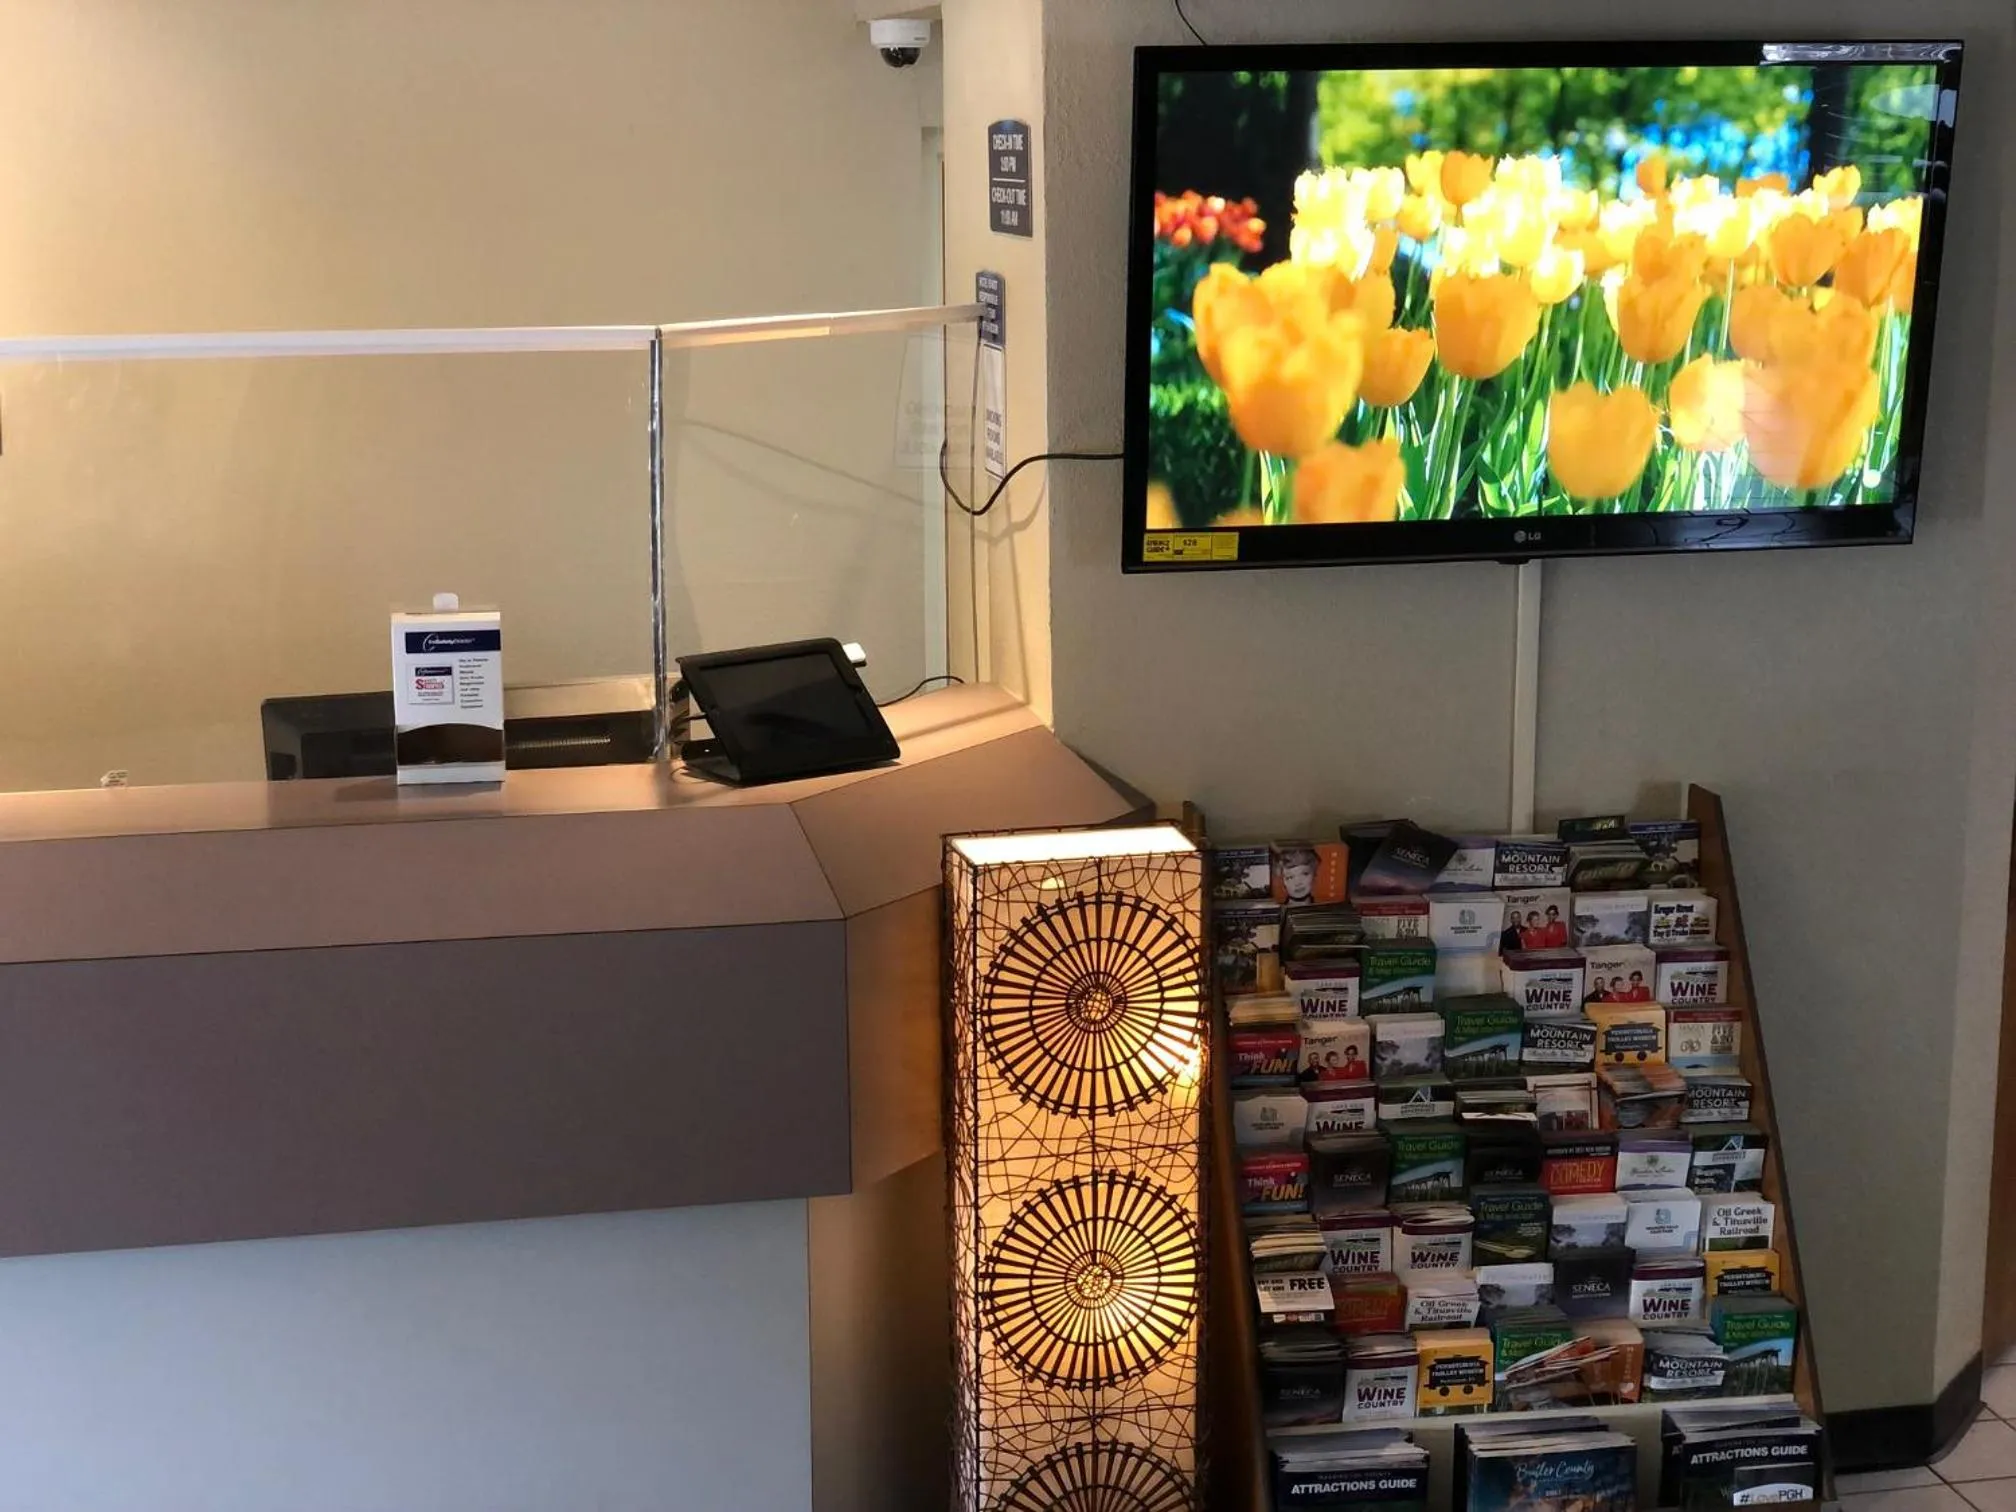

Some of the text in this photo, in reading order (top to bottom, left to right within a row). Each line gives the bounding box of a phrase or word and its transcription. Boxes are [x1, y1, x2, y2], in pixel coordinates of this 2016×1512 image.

[1528, 532, 1542, 540] LG
[1501, 854, 1561, 864] MOUNTAIN
[1508, 864, 1551, 873] RESORT
[1506, 894, 1540, 904] Tanger
[1590, 961, 1624, 970] Tanger
[1671, 982, 1718, 997] WINE
[1526, 988, 1573, 1004] WINE
[1300, 998, 1348, 1014] WINE
[1526, 1002, 1571, 1012] COUNTRY
[1530, 1028, 1592, 1042] MOUNTAIN
[1304, 1036, 1338, 1046] Tanger
[1536, 1039, 1581, 1050] RESORT
[1250, 1058, 1294, 1074] FUN!
[1692, 1098, 1738, 1109] RESORT
[1316, 1120, 1364, 1132] WINE
[1397, 1140, 1426, 1152] Travel
[1550, 1160, 1607, 1185] COMEDY
[1247, 1177, 1275, 1188] Think
[1262, 1184, 1305, 1200] FUN!
[1720, 1226, 1760, 1236] Railroad
[1331, 1250, 1380, 1266] WINE
[1411, 1252, 1460, 1264] WINE
[1332, 1264, 1380, 1274] COUNTRY
[1411, 1262, 1458, 1270] COUNTRY
[1289, 1277, 1325, 1291] FREE
[1642, 1298, 1691, 1313] WINE
[1421, 1314, 1462, 1322] Railroad
[1642, 1312, 1688, 1320] COUNTRY
[1660, 1360, 1722, 1370] MOUNTAIN
[1666, 1368, 1713, 1378] RESORT
[1358, 1388, 1406, 1402] WINE
[1358, 1400, 1404, 1409] COUNTRY
[1690, 1446, 1769, 1465] ATTRACTIONS
[1770, 1444, 1809, 1456] GUIDE
[1556, 1459, 1596, 1480] County
[1291, 1478, 1418, 1495] ATTRACTIONS GUIDE
